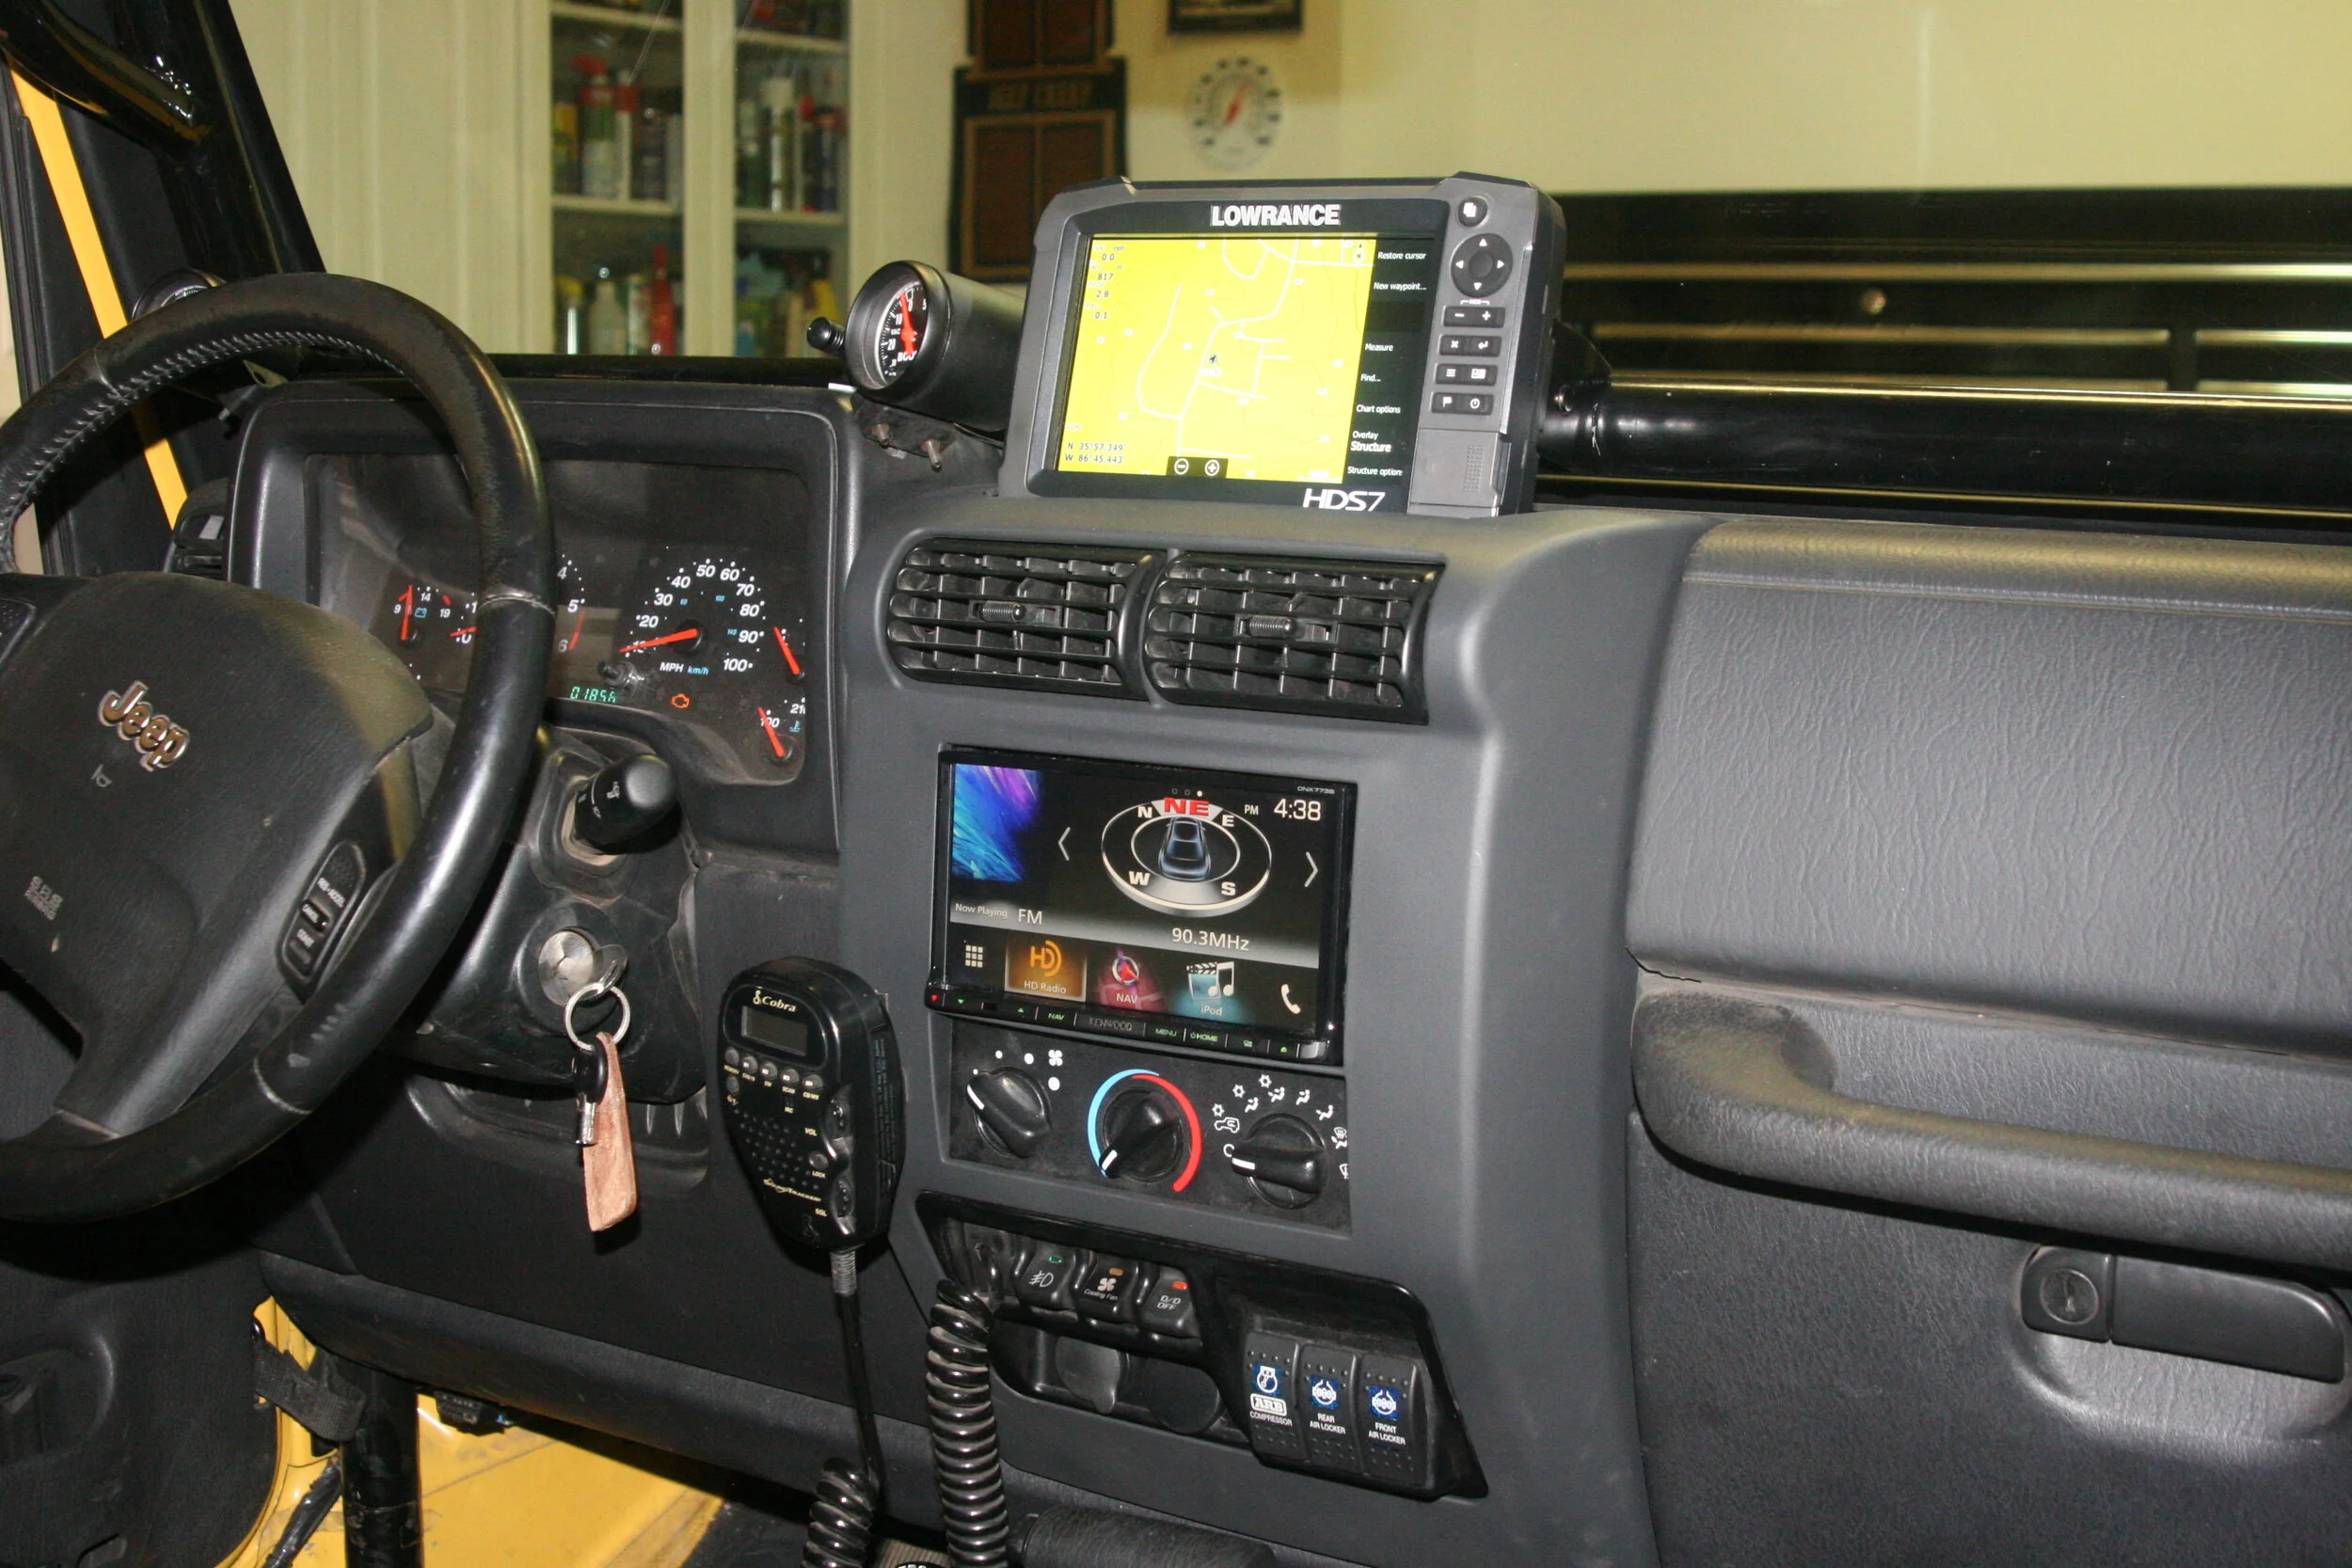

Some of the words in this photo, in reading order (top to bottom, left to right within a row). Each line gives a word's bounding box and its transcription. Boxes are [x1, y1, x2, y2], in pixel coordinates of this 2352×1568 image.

[1210, 203, 1341, 227] LOWRANCE
[1377, 251, 1403, 260] Restore
[1391, 282, 1427, 291] waypoint...
[1096, 290, 1109, 298] 2.8
[1356, 404, 1375, 413] Chart
[1375, 405, 1401, 414] options
[1352, 430, 1378, 439] Overlay
[1350, 441, 1391, 452] Structure
[1347, 466, 1378, 475] Structure
[1302, 487, 1386, 512] HDS7
[558, 566, 567, 579] 4
[695, 565, 715, 578] 50
[720, 568, 739, 581] 60
[671, 576, 691, 589] 40
[736, 583, 755, 596] 70
[421, 593, 431, 601] 14
[654, 594, 673, 607] 30
[393, 604, 402, 613] 9
[567, 599, 579, 613] 5
[739, 604, 759, 617] 80
[439, 608, 451, 618] 19
[639, 615, 659, 628] 20
[739, 630, 758, 643] 90
[558, 640, 568, 653] 6
[660, 662, 684, 673] MPH
[687, 666, 709, 675] km/h
[723, 658, 748, 672] 100
[97, 680, 190, 772] Jeep
[1137, 806, 1152, 818] N
[1163, 798, 1211, 816] NE
[1244, 804, 1259, 816] PM
[1274, 798, 1321, 821] 4:38
[1222, 815, 1234, 827] E
[1129, 871, 1151, 886] W
[1221, 882, 1236, 896] S
[955, 903, 976, 913] Now
[977, 906, 1009, 919] Playing
[1018, 909, 1042, 925] FM
[1171, 927, 1249, 951] 90.3MHz
[1024, 980, 1039, 990] HD
[1041, 983, 1067, 994] Radio
[762, 996, 797, 1013] Cobra
[1116, 993, 1138, 1004] NAV
[1048, 1012, 1065, 1021] NAV
[1200, 1006, 1223, 1016] iPod
[1155, 1028, 1177, 1037] MENU
[1196, 1034, 1218, 1042] HOME
[804, 1128, 818, 1136] VOL
[1084, 1288, 1106, 1299] Cooling
[1106, 1292, 1119, 1301] Fan
[1157, 1302, 1177, 1310] OFF
[1253, 1398, 1285, 1414] ARB
[1249, 1411, 1294, 1427] COMPRESSOR
[1317, 1413, 1336, 1424] REAR
[1310, 1420, 1322, 1429] AIR
[1321, 1422, 1346, 1434] LOCKER
[1375, 1421, 1398, 1434] FRONT
[1368, 1430, 1380, 1439] AIR
[1379, 1433, 1406, 1446] LOCKER
